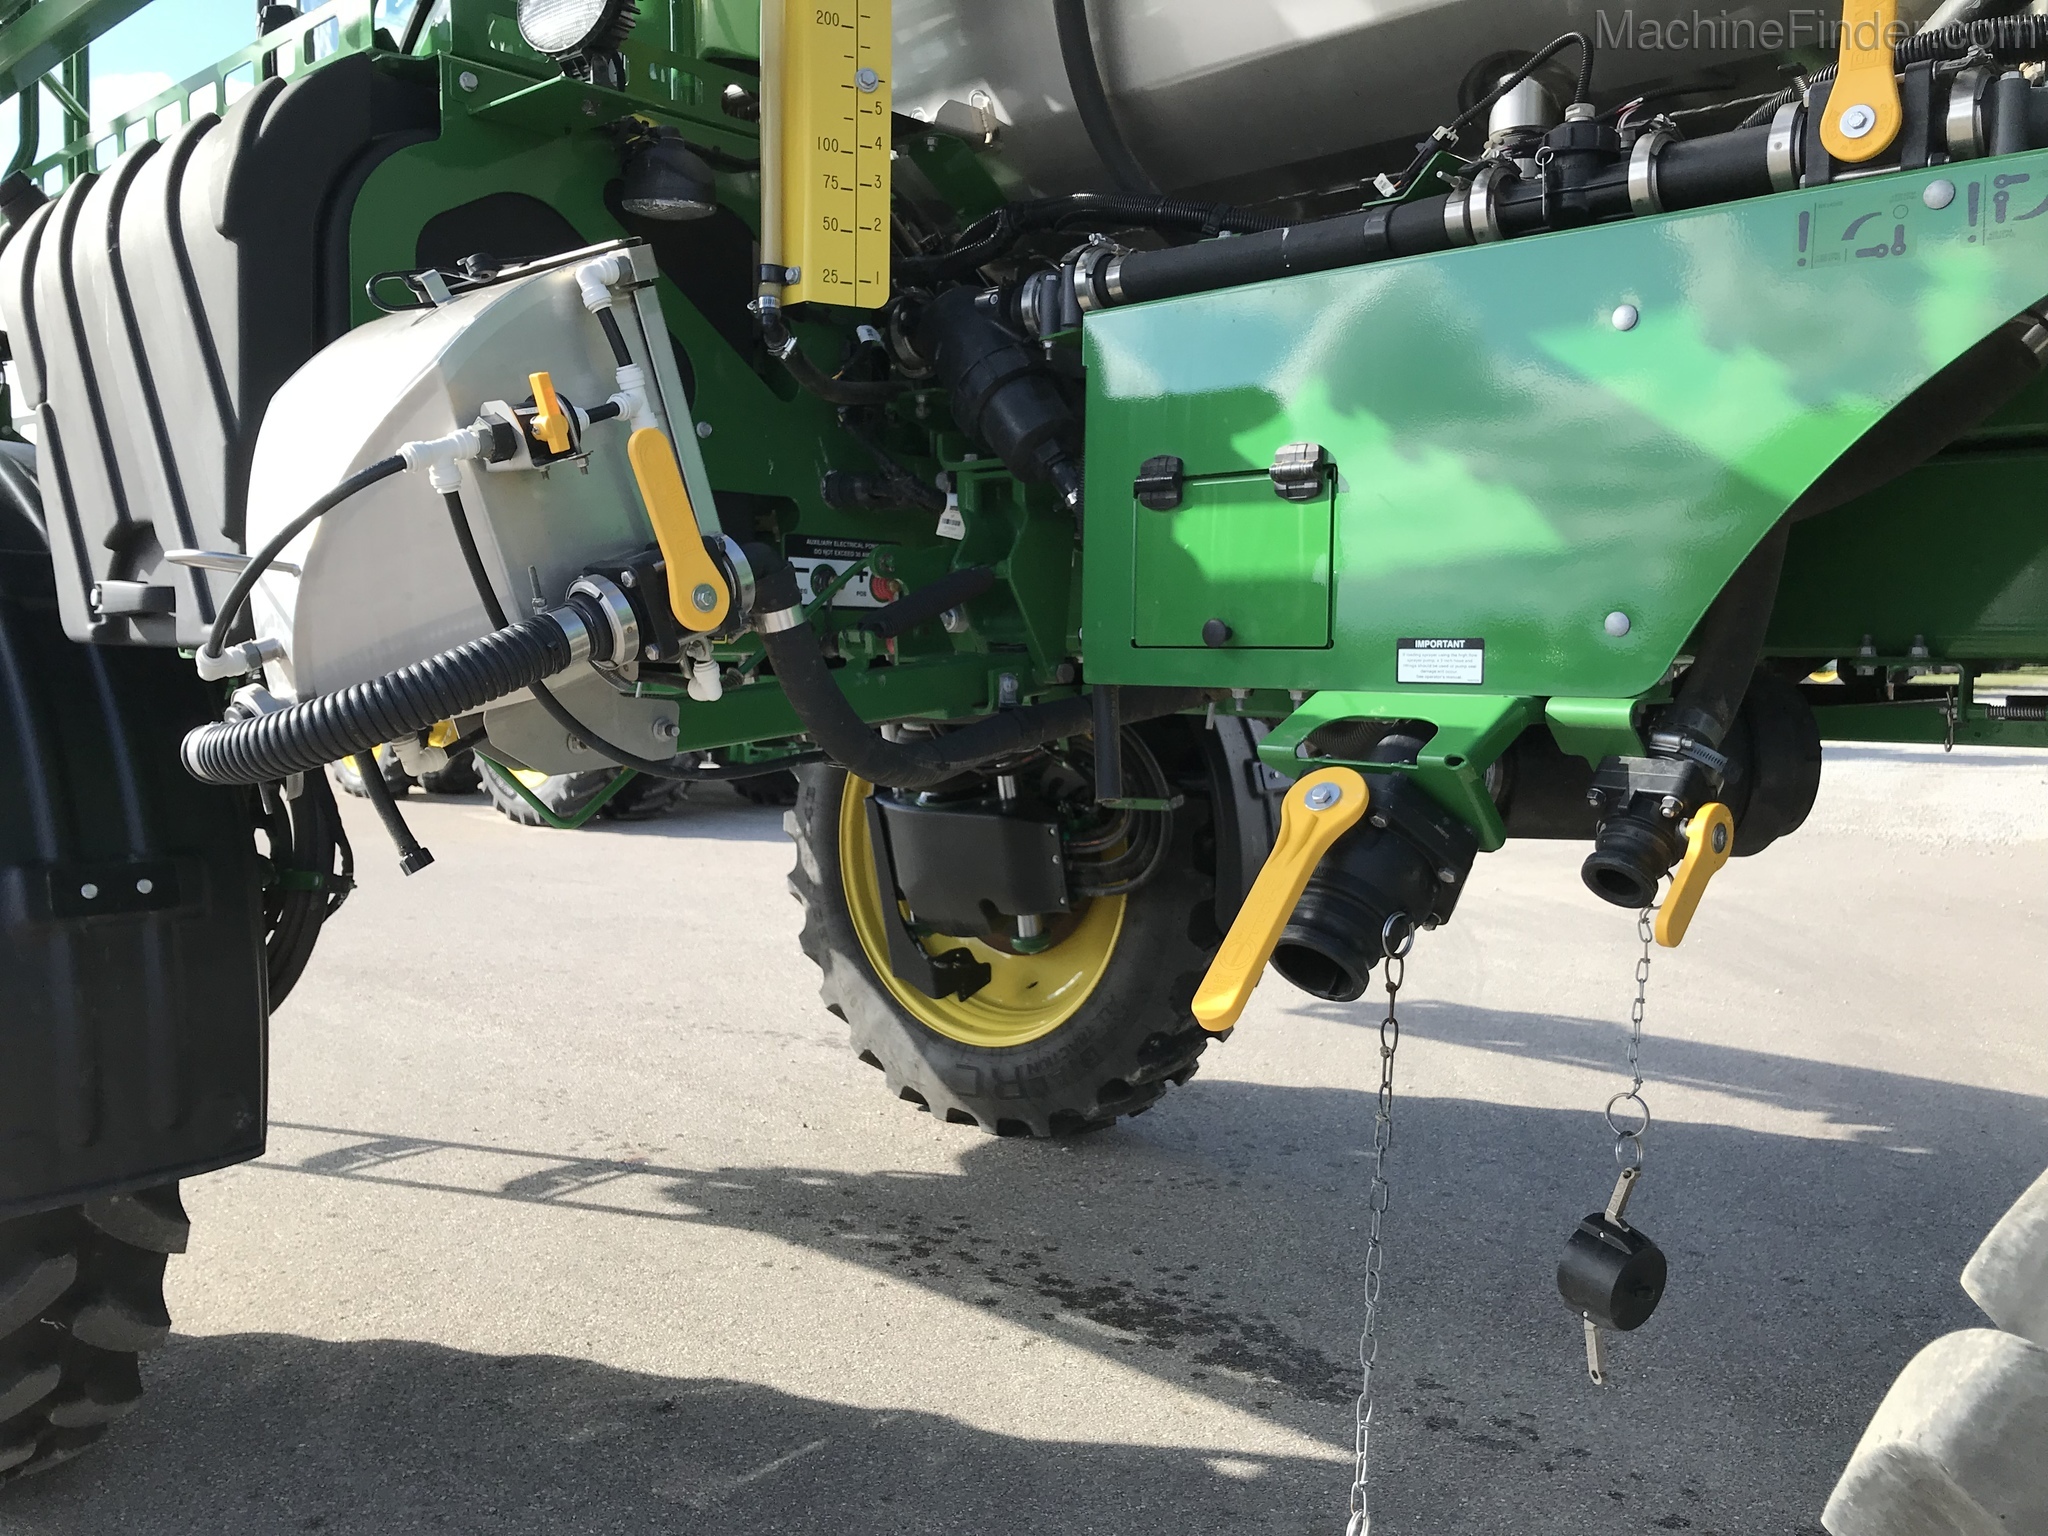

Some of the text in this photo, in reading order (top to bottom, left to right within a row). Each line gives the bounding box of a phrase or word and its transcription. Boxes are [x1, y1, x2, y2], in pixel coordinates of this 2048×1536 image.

[816, 10, 840, 27] 200
[875, 101, 883, 116] 5
[817, 136, 839, 152] 100
[874, 136, 882, 150] 4
[823, 175, 839, 190] 75
[874, 175, 882, 189] 3
[822, 217, 838, 231] 50
[874, 218, 882, 232] 2
[822, 269, 838, 284] 25
[875, 271, 880, 285] 1
[806, 538, 833, 547] AUXILIARY
[834, 540, 864, 549] ELECTRICAL
[834, 550, 854, 558] EXCEED
[1414, 639, 1466, 649] IMPORTANT
